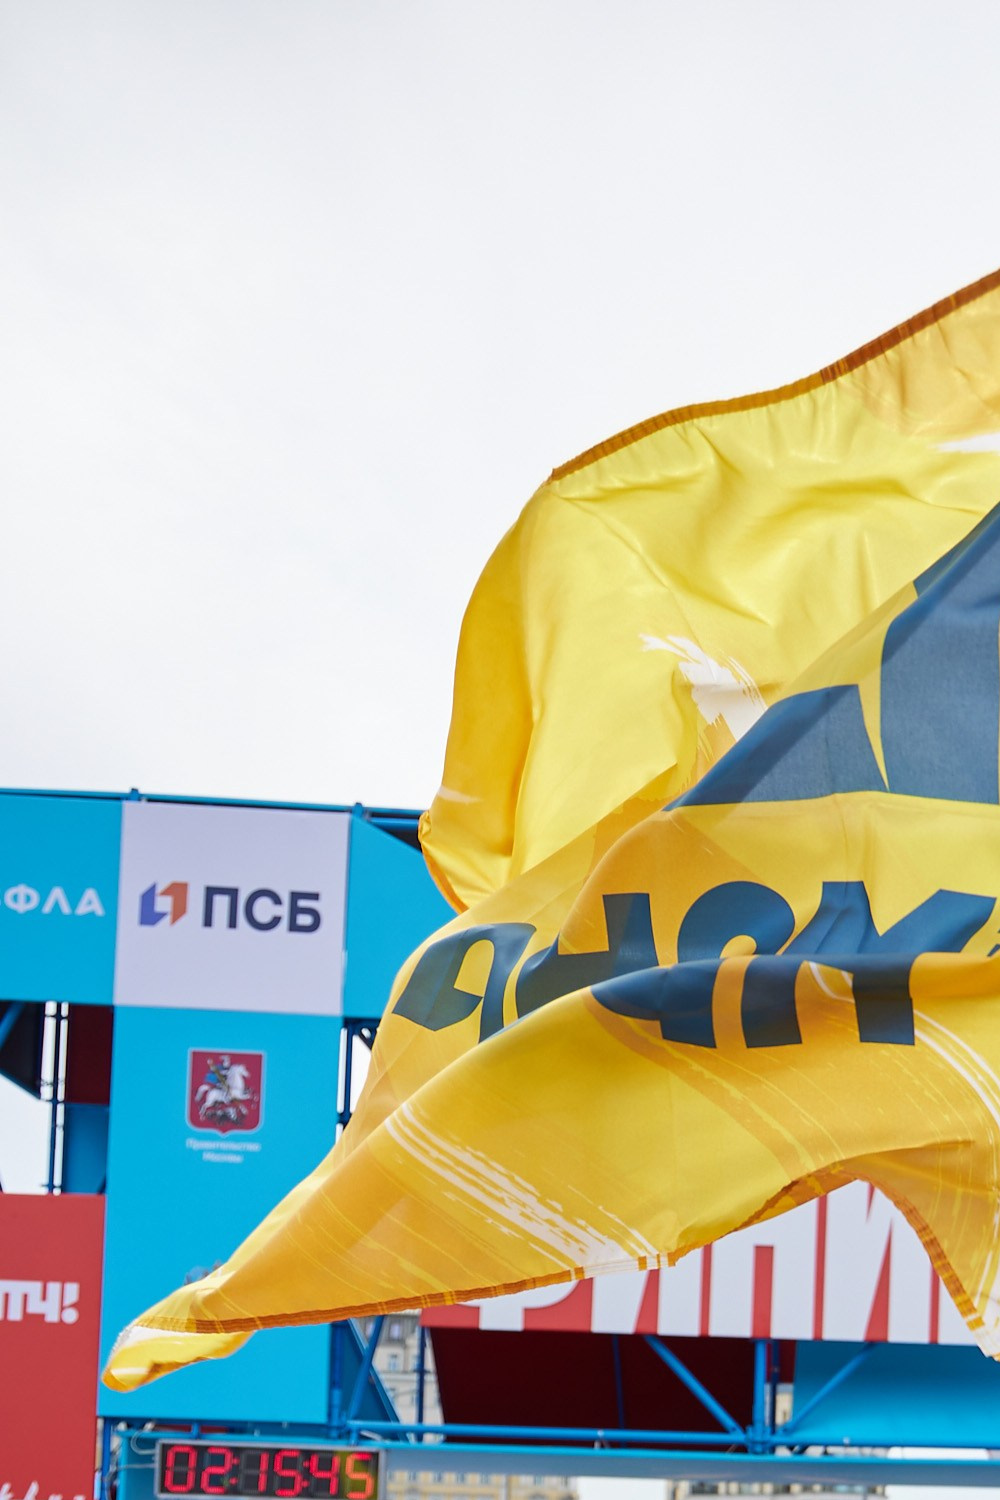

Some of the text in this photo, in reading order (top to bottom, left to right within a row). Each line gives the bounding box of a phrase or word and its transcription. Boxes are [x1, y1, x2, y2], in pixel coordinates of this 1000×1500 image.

[0, 883, 106, 917] ФЛА
[203, 886, 321, 933] ПСБ
[164, 1445, 374, 1500] 02:15:45
